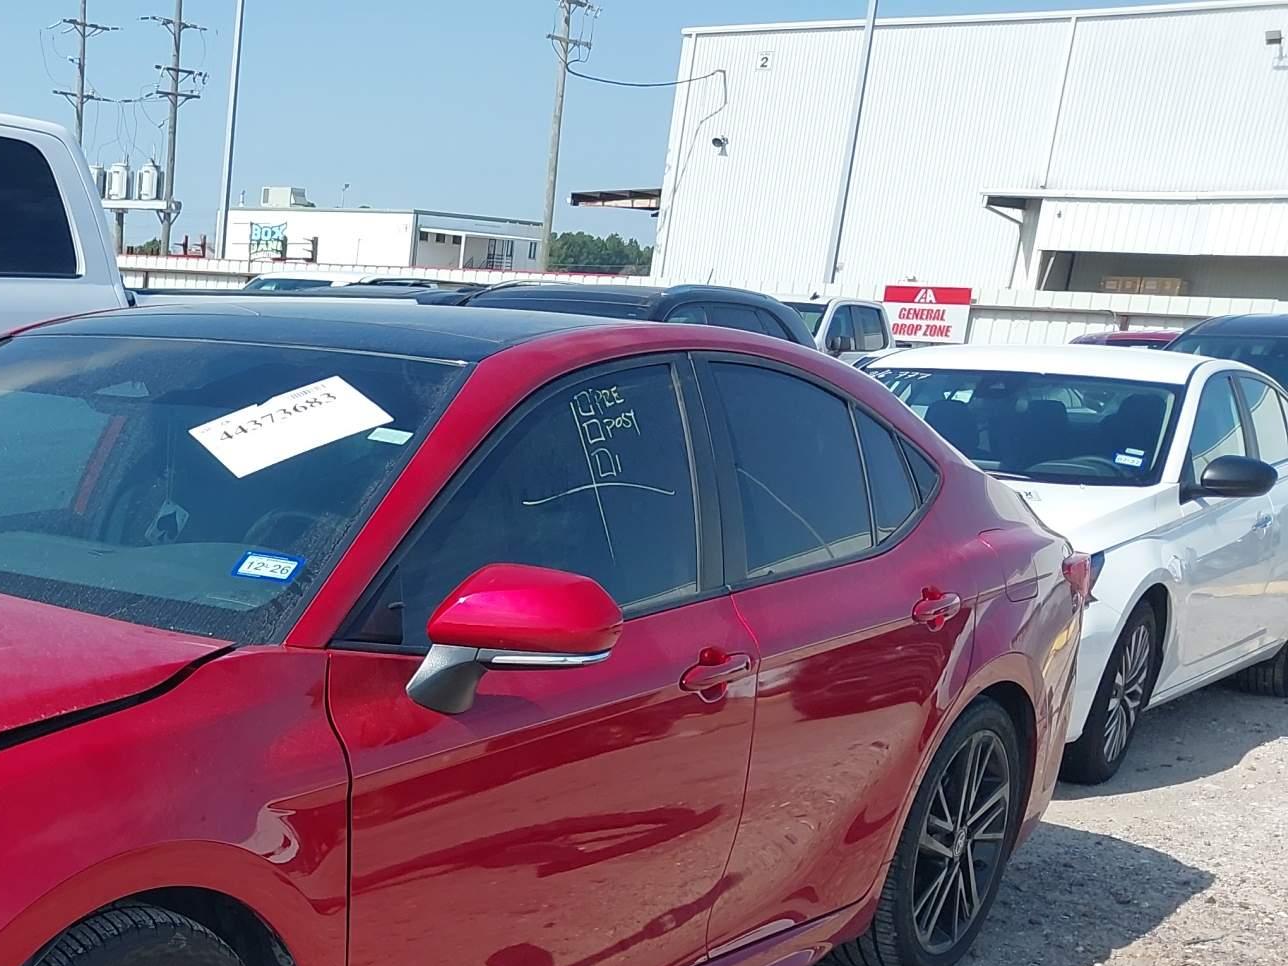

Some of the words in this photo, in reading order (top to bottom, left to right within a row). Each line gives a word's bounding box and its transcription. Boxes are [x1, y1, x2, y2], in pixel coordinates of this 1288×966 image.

[760, 56, 769, 68] 2
[898, 307, 946, 321] GENERAL
[892, 322, 922, 336] DROP
[922, 324, 952, 337] ZONE
[219, 392, 337, 441] 44373683
